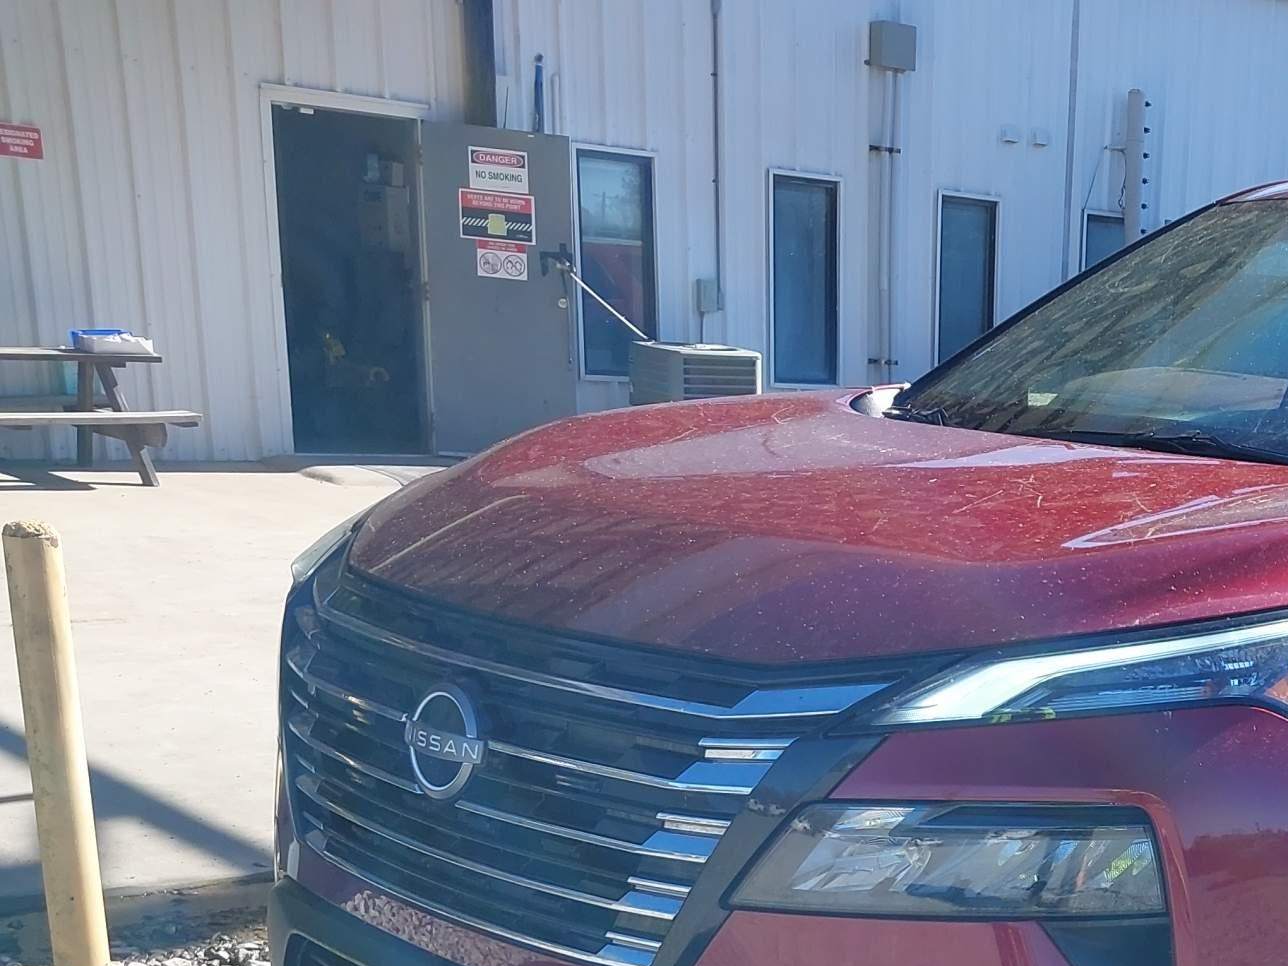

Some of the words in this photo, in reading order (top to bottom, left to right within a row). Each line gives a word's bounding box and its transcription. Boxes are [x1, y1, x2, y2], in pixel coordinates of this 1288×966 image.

[479, 153, 517, 165] DANGER
[475, 169, 487, 179] NO
[488, 171, 523, 183] SMOKING
